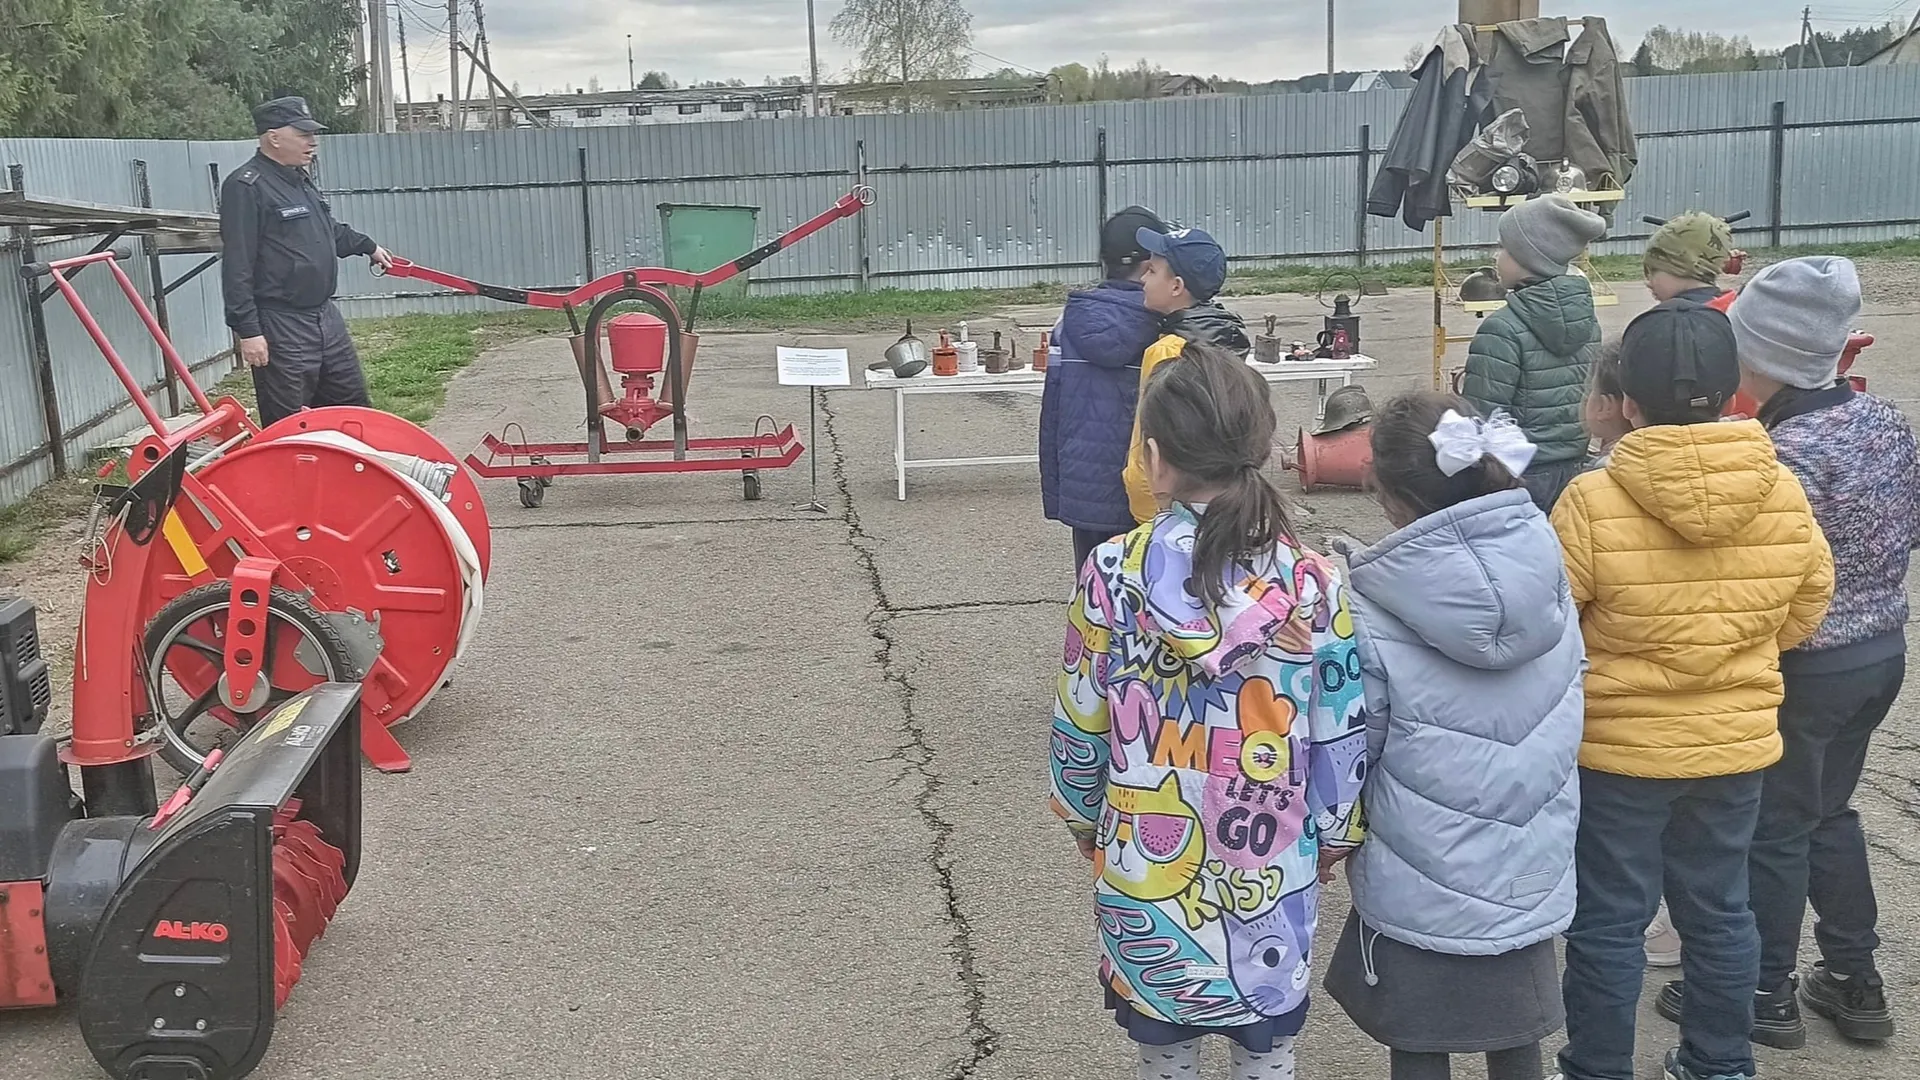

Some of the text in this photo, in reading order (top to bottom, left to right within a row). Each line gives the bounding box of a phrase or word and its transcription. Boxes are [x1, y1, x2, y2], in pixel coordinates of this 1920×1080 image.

[1225, 773, 1294, 812] LET'S
[1216, 806, 1277, 857] GO
[153, 919, 229, 943] AL-KO
